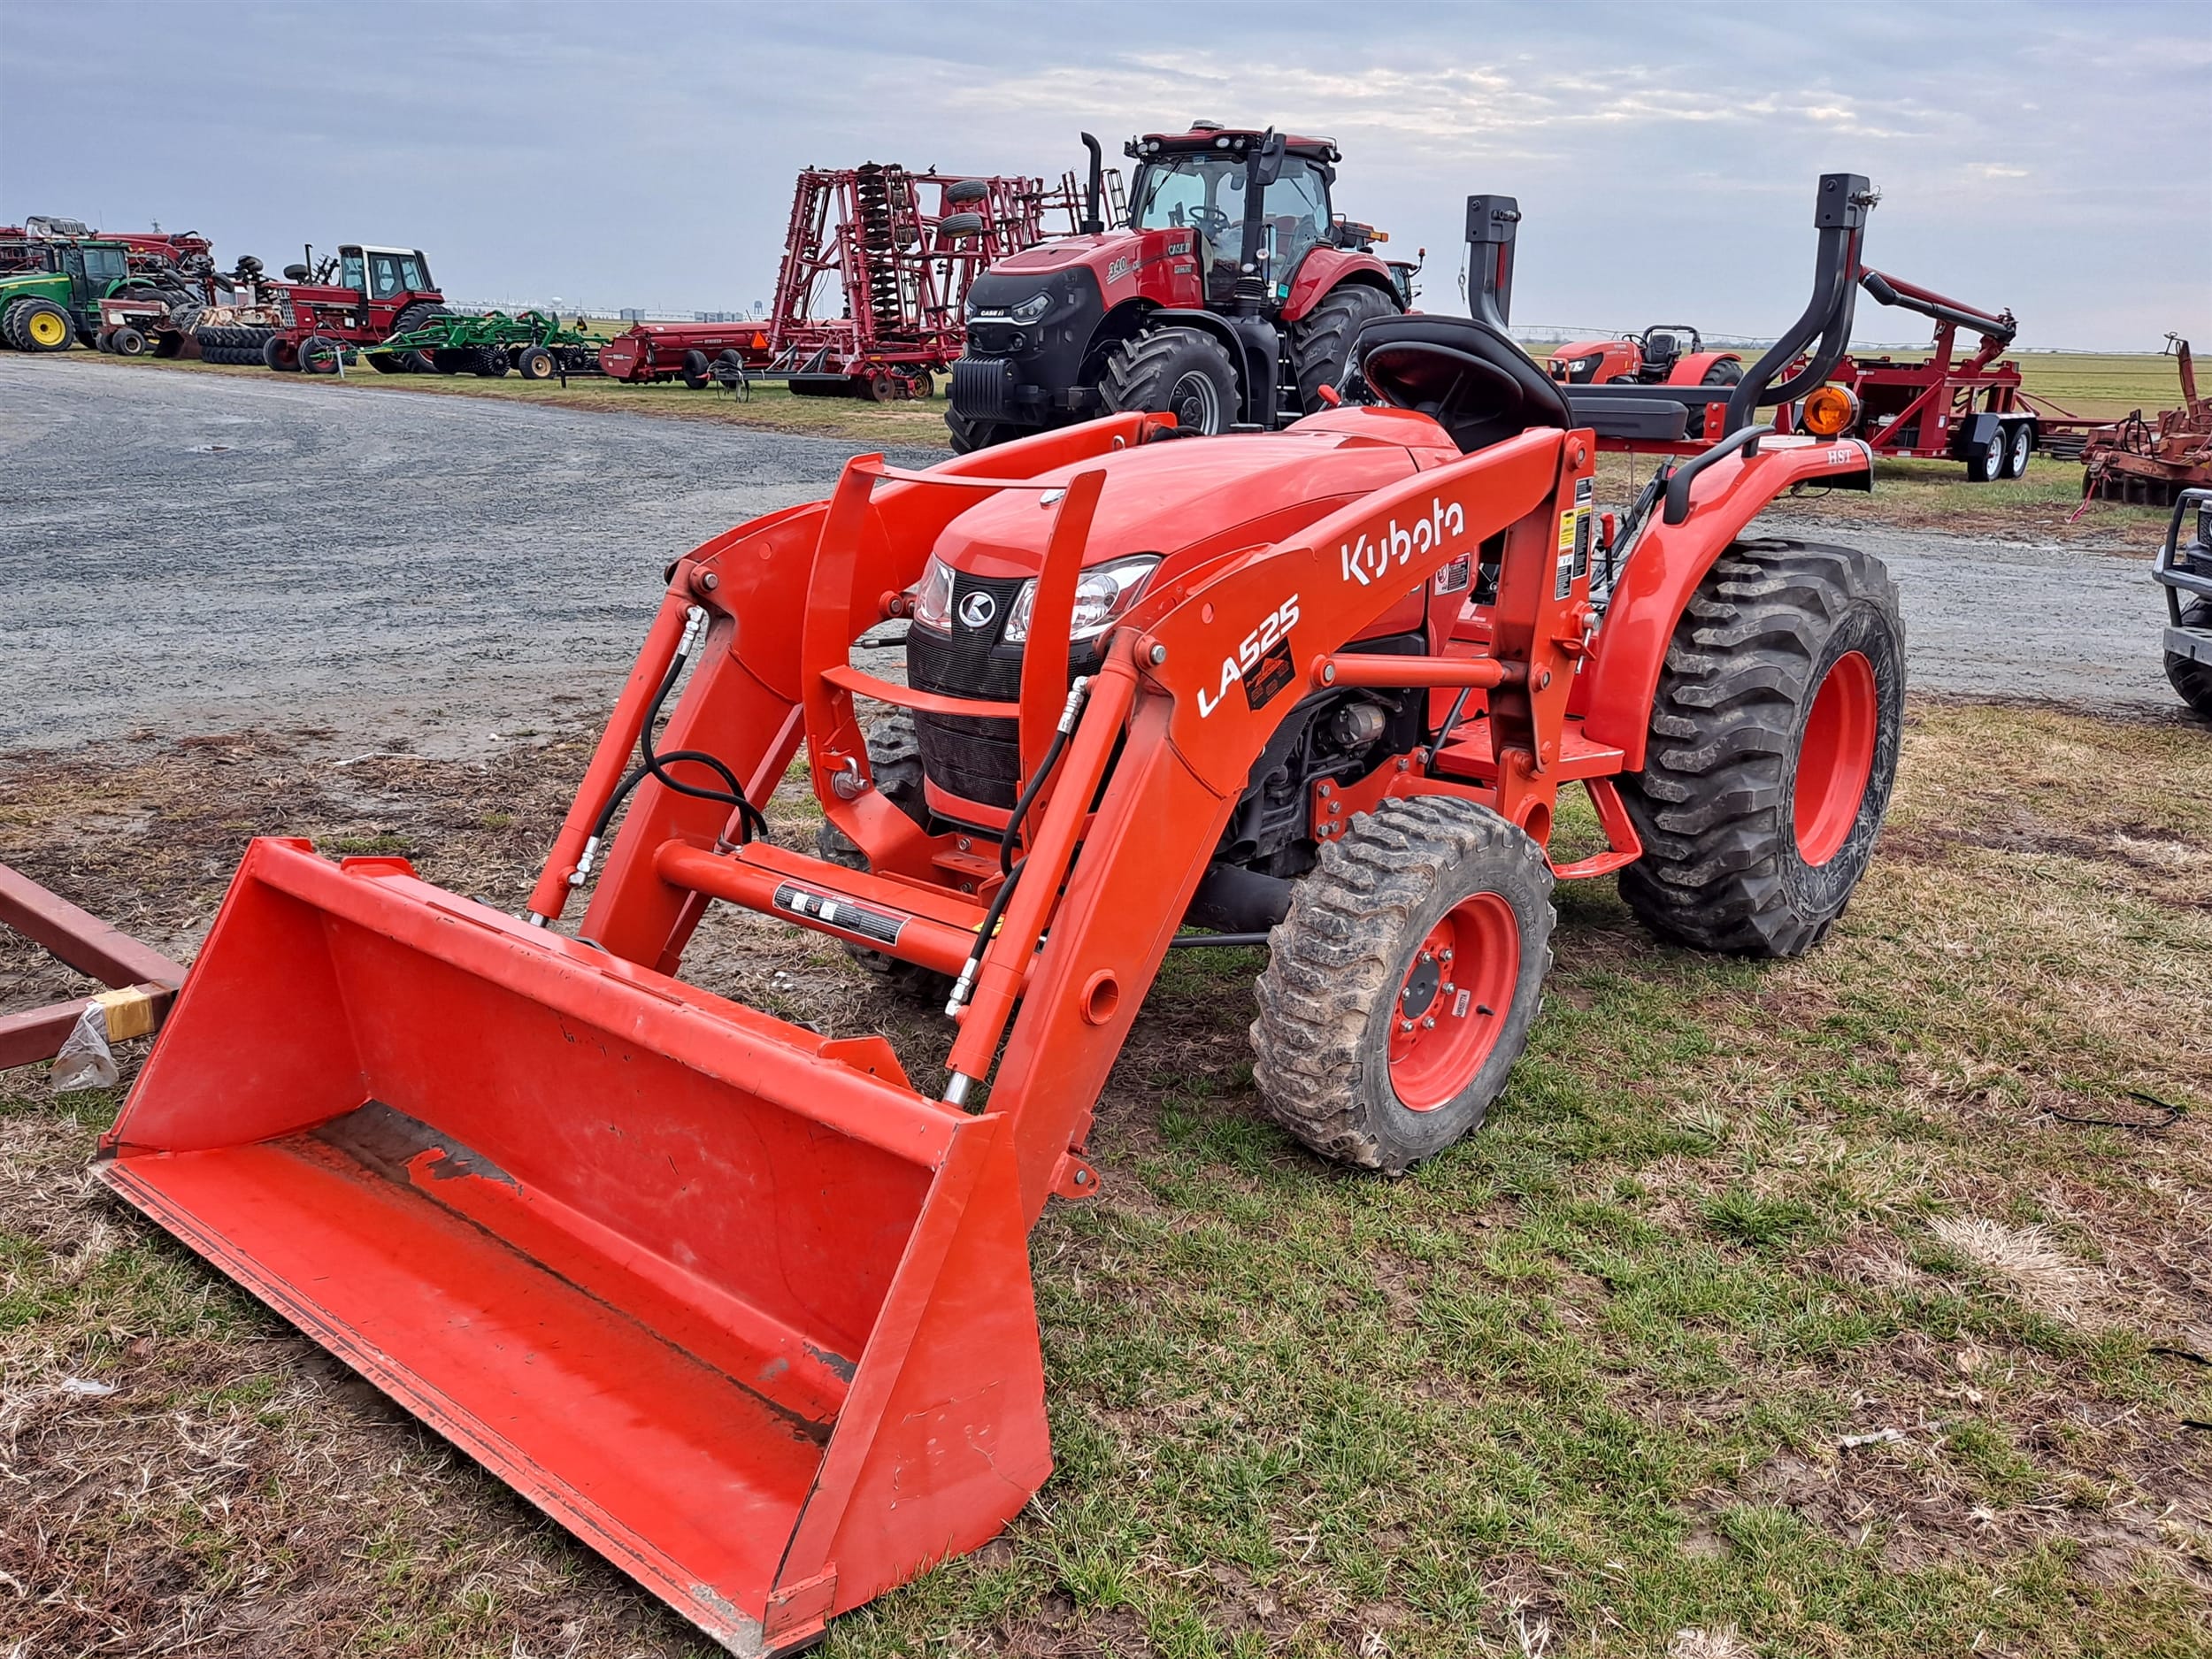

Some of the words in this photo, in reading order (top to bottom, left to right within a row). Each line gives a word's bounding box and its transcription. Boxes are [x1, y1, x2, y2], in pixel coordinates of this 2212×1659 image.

[1109, 256, 1128, 277] 340
[1827, 449, 1853, 465] HST
[1340, 497, 1464, 586] Kubota
[1196, 593, 1300, 718] LA525
